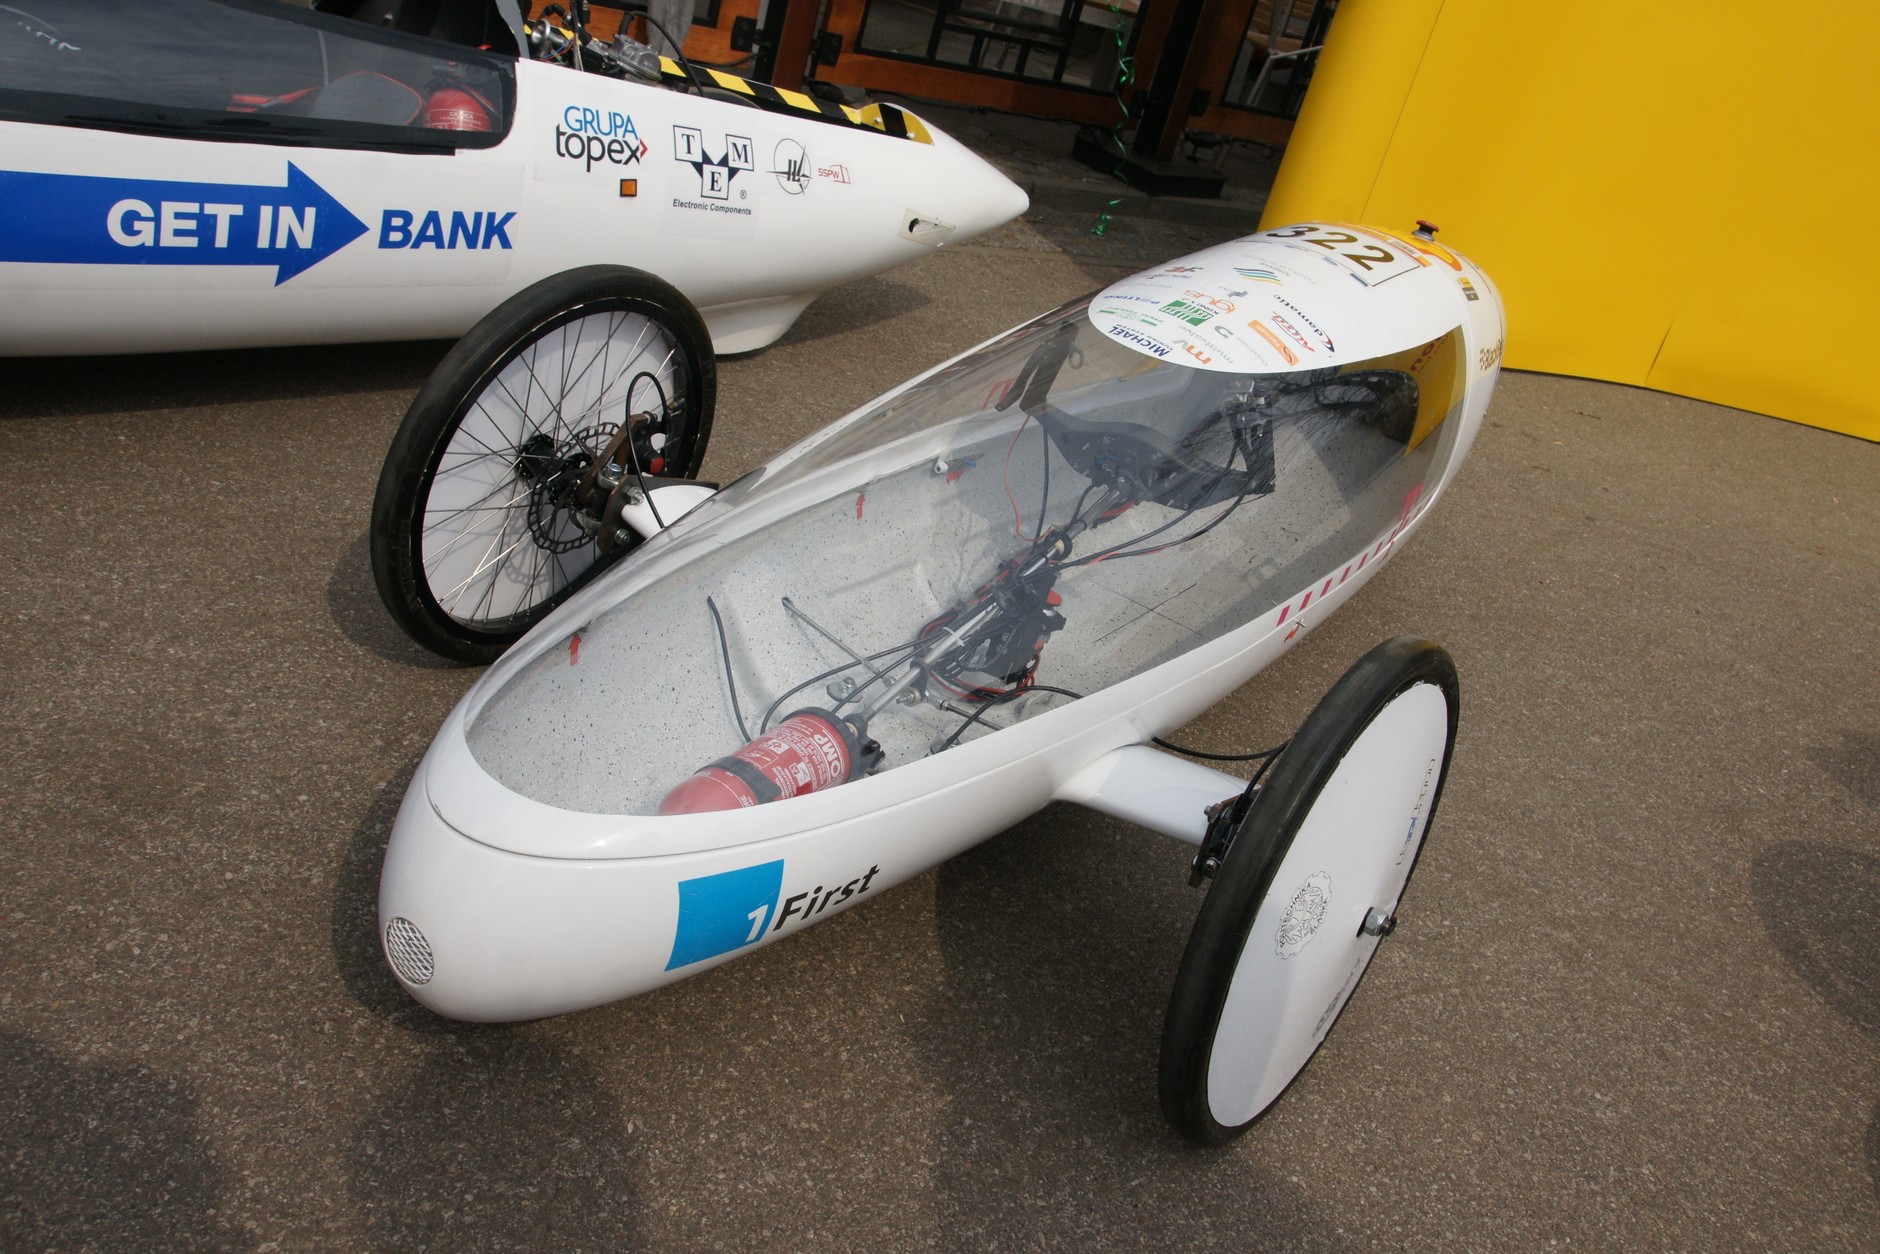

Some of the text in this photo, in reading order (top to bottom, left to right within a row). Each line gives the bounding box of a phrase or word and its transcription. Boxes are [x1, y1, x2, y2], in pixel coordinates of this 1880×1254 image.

[564, 106, 638, 140] GRUPA
[555, 123, 640, 172] topex
[106, 198, 518, 251] GET IN BANK
[672, 199, 752, 216] Electronic Components
[1266, 226, 1395, 272] 322
[1183, 289, 1237, 315] igus
[1107, 325, 1174, 358] MICHAEL
[1172, 339, 1213, 366] mv
[1178, 325, 1235, 365] multivalve
[813, 733, 841, 778] OMP
[772, 864, 881, 933] First
